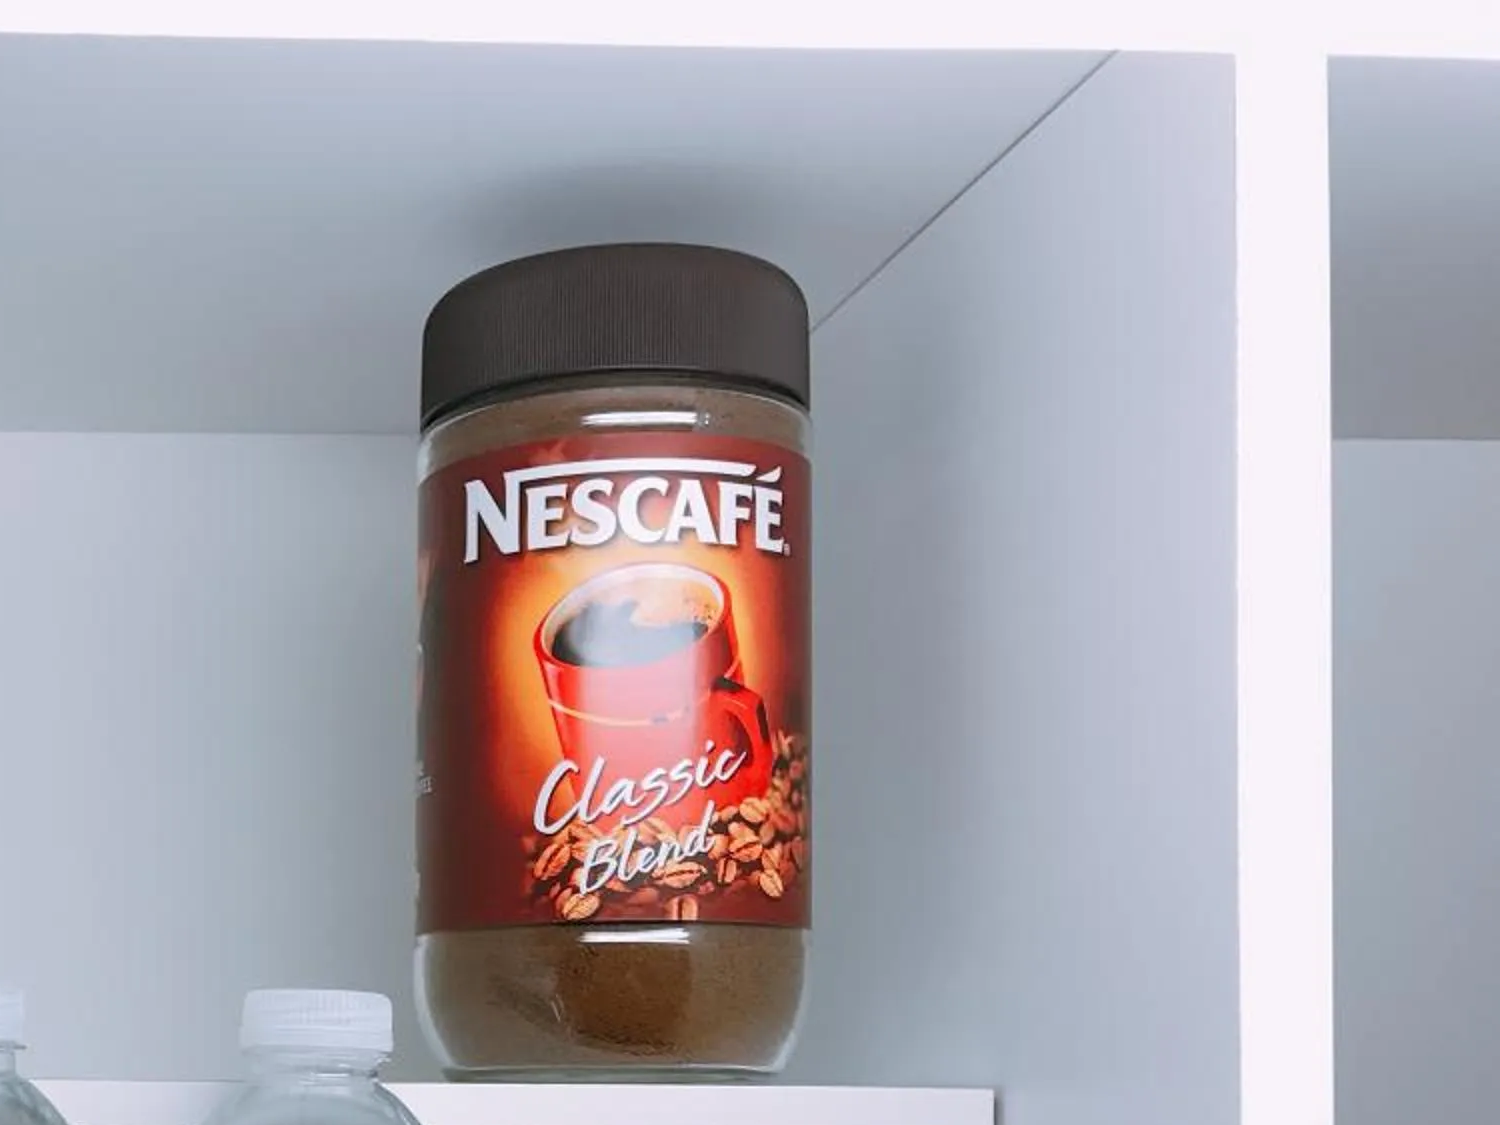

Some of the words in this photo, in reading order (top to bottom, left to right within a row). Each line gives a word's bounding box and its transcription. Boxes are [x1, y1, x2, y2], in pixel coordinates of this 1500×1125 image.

[463, 457, 786, 564] NESCAFÉ
[533, 741, 747, 836] Classic
[578, 800, 717, 895] Blend
